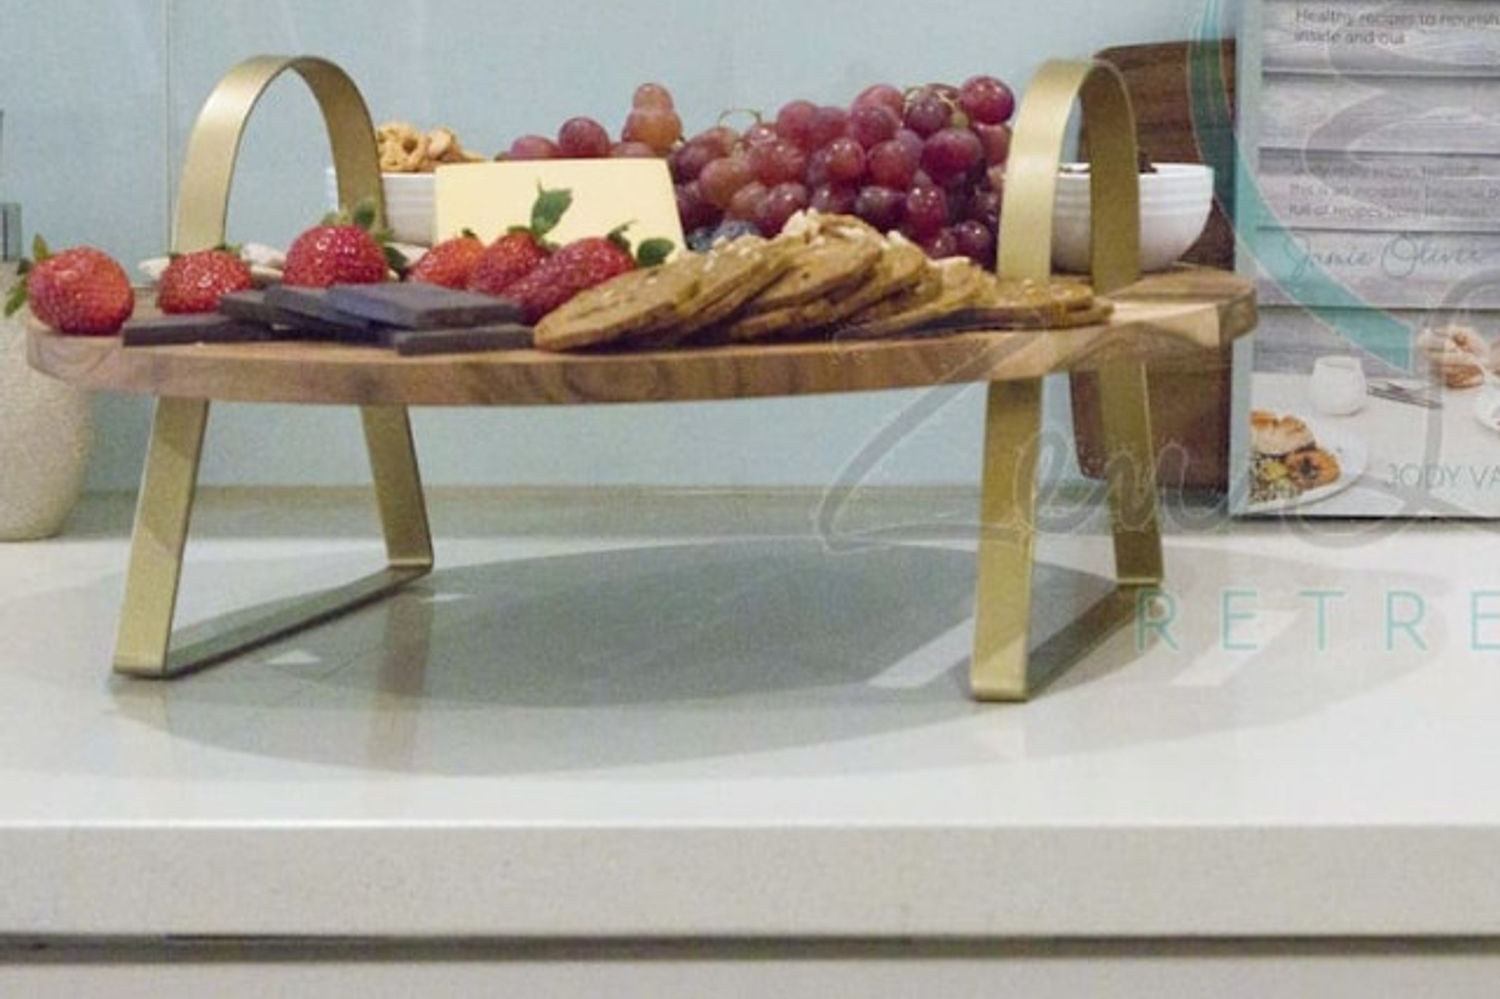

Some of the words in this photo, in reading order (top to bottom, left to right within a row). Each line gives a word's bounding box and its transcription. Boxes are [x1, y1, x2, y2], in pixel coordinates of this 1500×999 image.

[1296, 8, 1352, 27] Healthy
[1420, 13, 1436, 25] to
[1345, 31, 1375, 44] and
[1385, 463, 1461, 490] JODY
